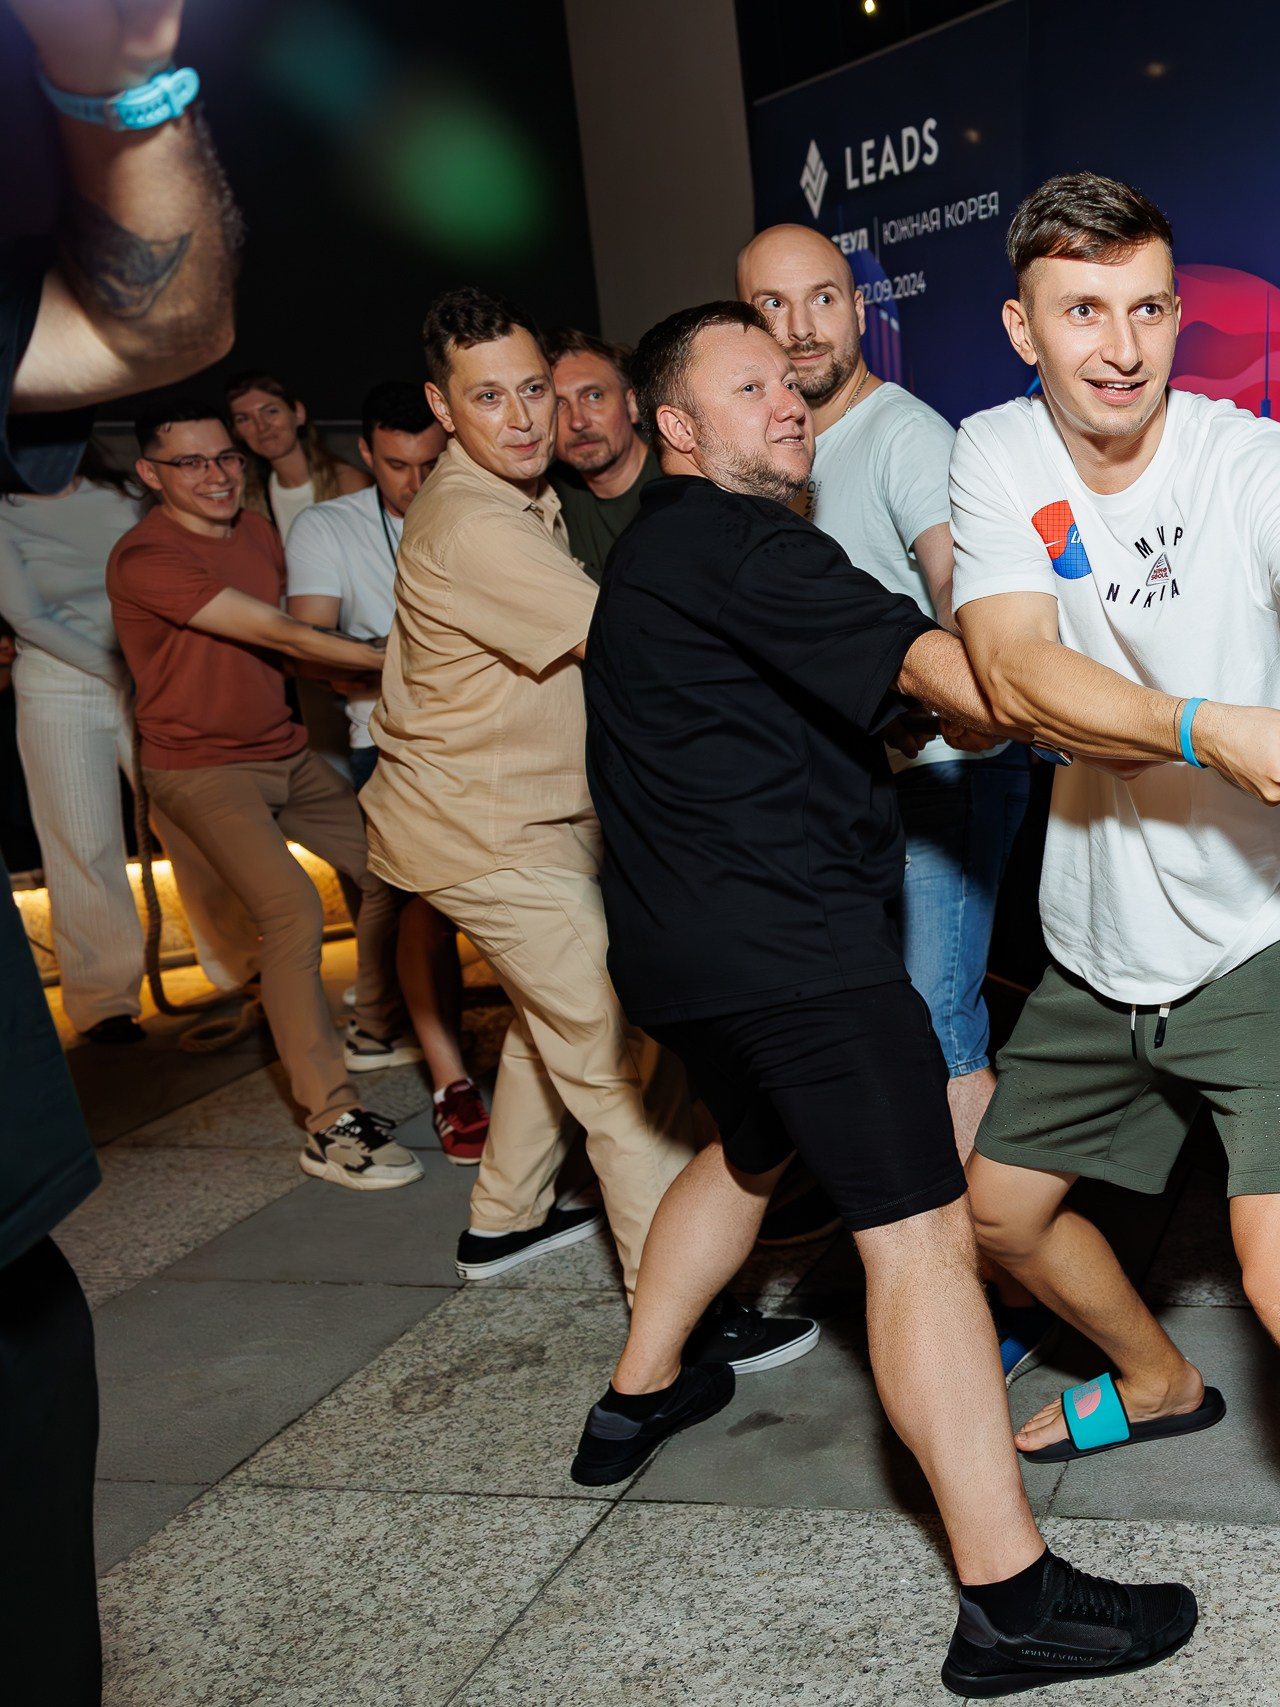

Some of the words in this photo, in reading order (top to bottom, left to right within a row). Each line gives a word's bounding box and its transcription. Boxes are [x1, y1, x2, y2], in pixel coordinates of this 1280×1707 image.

[845, 118, 940, 190] LEADS
[882, 207, 941, 245] ЮЖНАЯ
[945, 191, 1000, 229] КОРЕЯ
[1134, 525, 1183, 559] MVP
